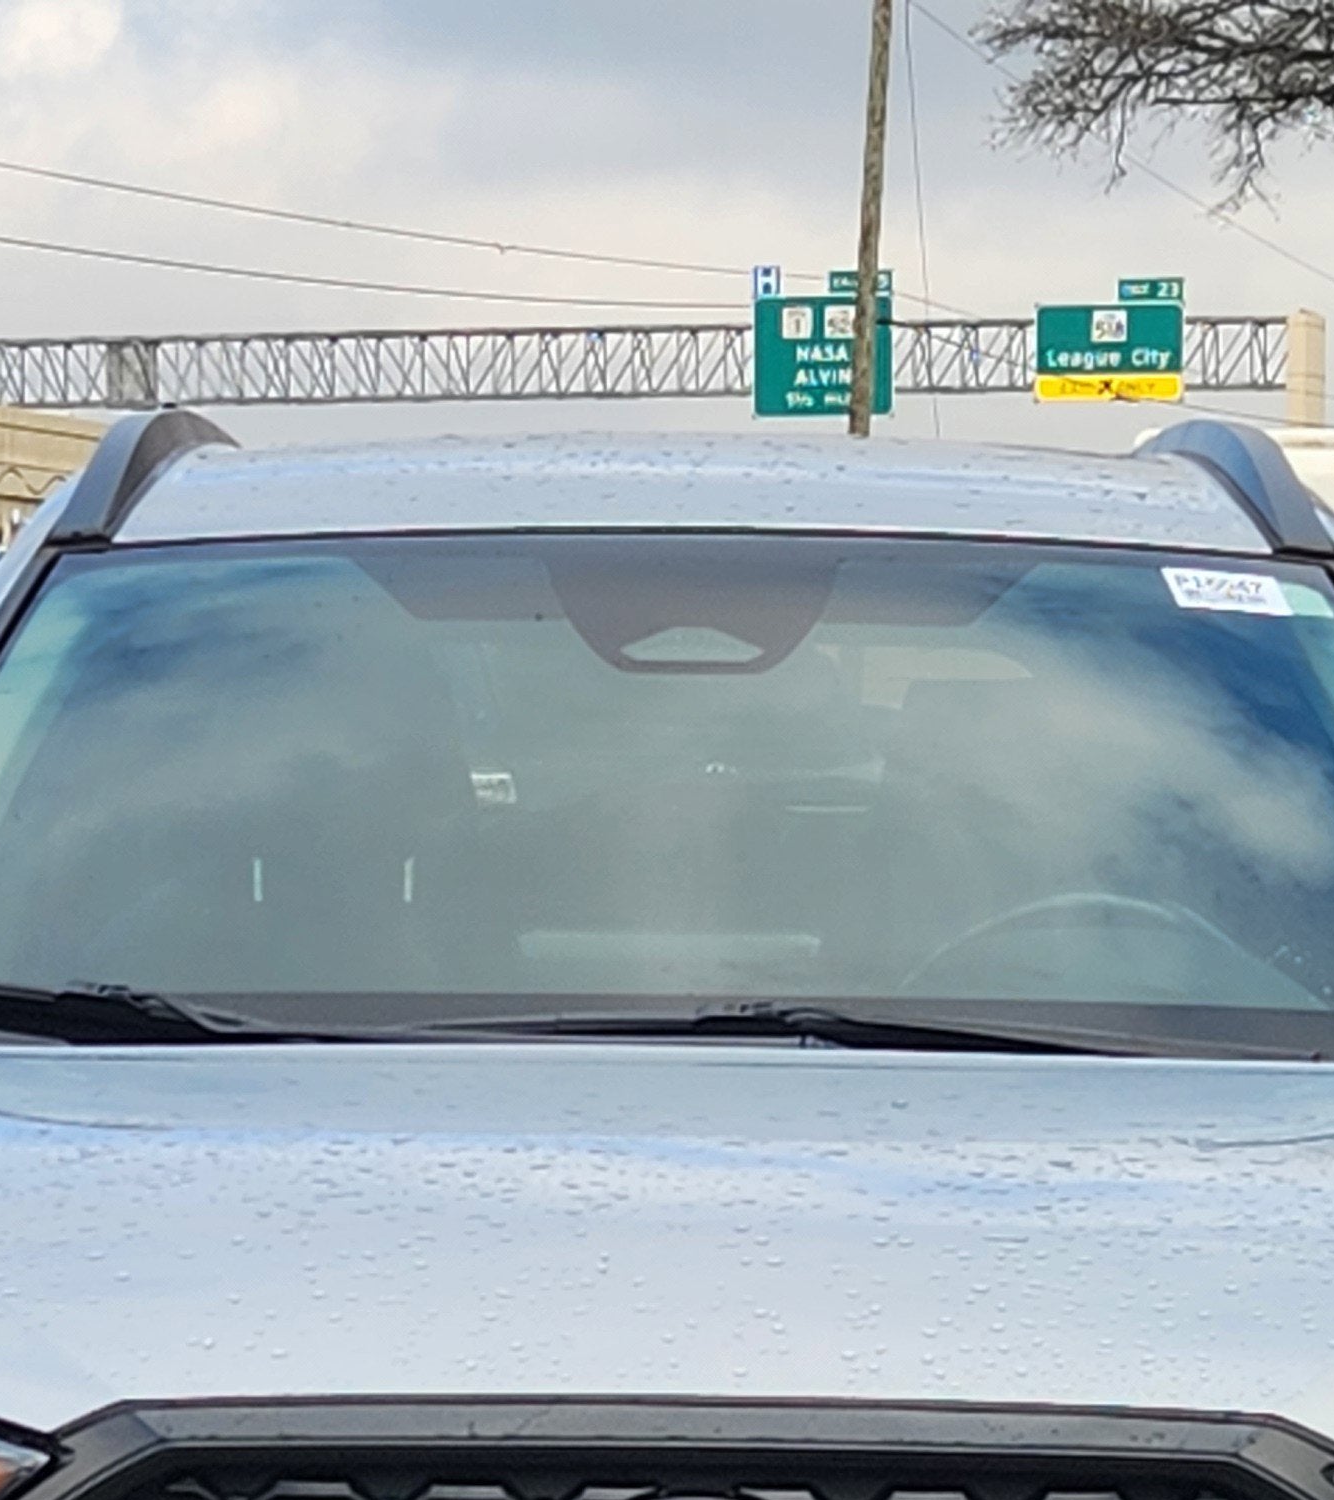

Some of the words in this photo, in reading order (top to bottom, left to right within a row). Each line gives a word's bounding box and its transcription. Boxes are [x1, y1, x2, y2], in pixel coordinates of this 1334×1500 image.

[1157, 282, 1180, 297] 23
[796, 344, 849, 363] NASA
[1046, 349, 1123, 370] League
[1131, 347, 1172, 370] City
[794, 368, 853, 387] ALVIN
